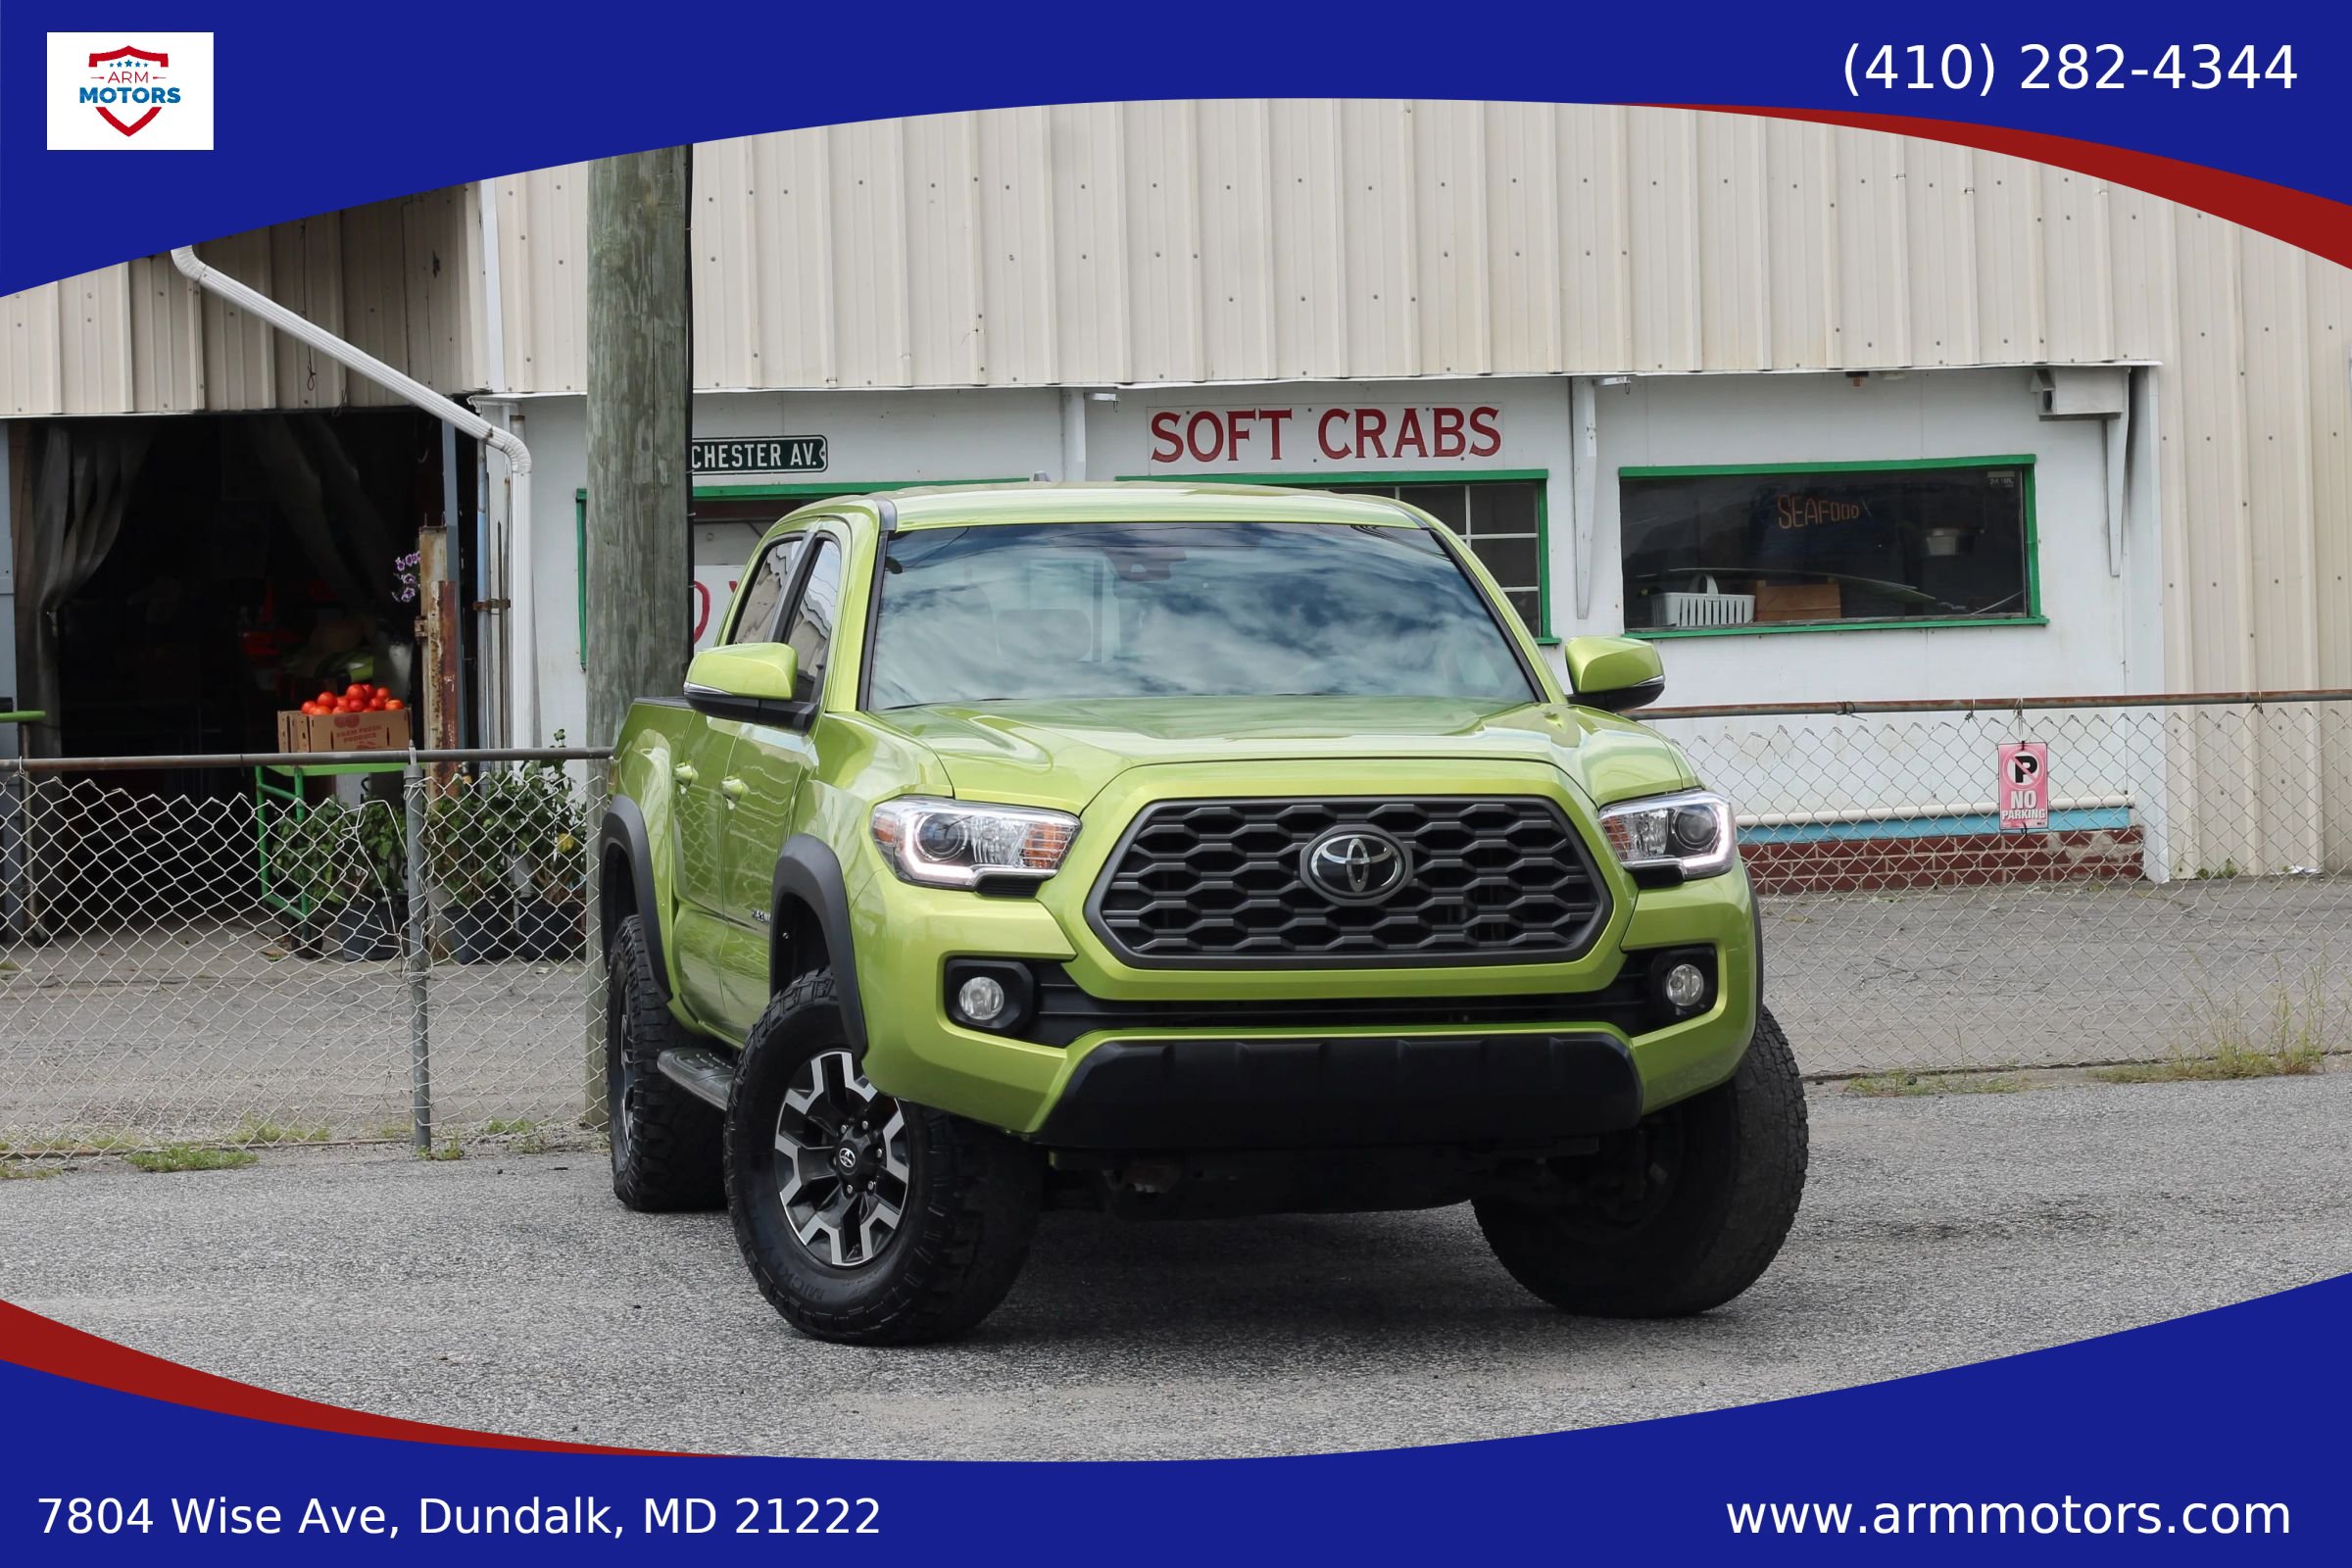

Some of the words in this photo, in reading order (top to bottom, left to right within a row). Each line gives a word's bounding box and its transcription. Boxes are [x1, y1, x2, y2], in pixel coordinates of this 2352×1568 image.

[1151, 408, 1293, 464] SOFT
[1317, 406, 1501, 460] CRABS
[691, 444, 781, 469] CHESTER
[790, 442, 817, 466] AV.
[1777, 494, 1860, 529] SEAFOOD
[2010, 790, 2037, 810] NO
[2001, 808, 2046, 820] PARKING
